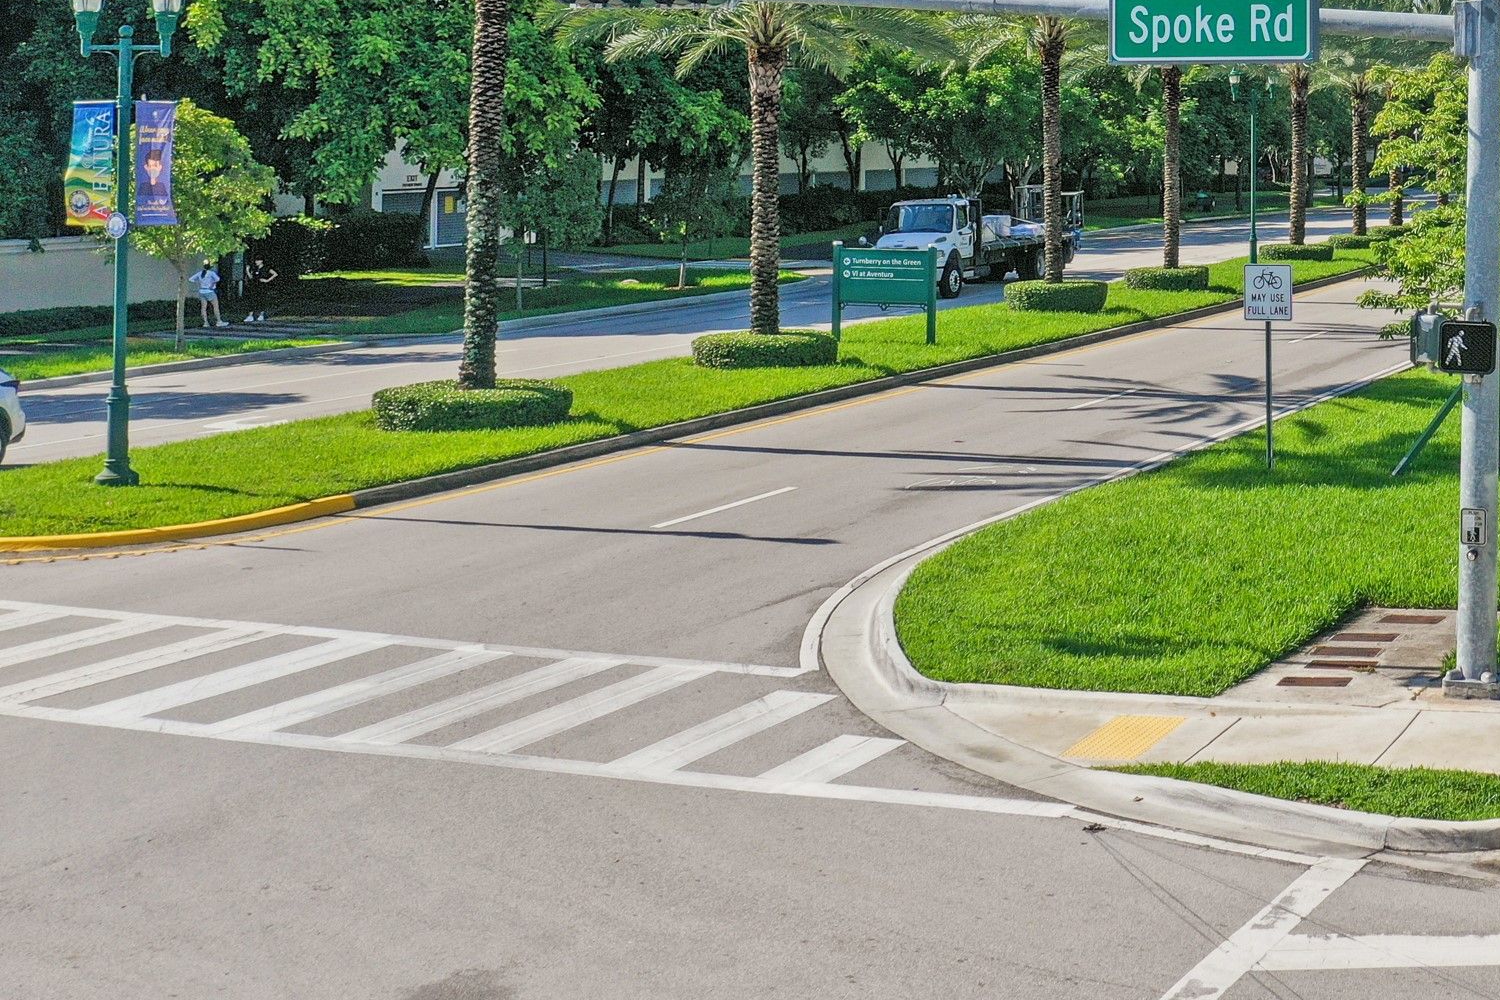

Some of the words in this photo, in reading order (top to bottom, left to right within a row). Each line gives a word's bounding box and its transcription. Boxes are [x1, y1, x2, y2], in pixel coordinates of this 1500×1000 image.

[1129, 4, 1235, 53] Spoke
[1250, 3, 1293, 42] Rd
[92, 110, 111, 217] AVENTURA
[852, 257, 881, 266] Turnberry
[892, 258, 902, 266] the
[903, 258, 922, 266] Green
[1251, 293, 1266, 303] MAY
[1270, 293, 1285, 303] USE
[1247, 306, 1266, 315] FULL
[1270, 306, 1289, 316] LANE
